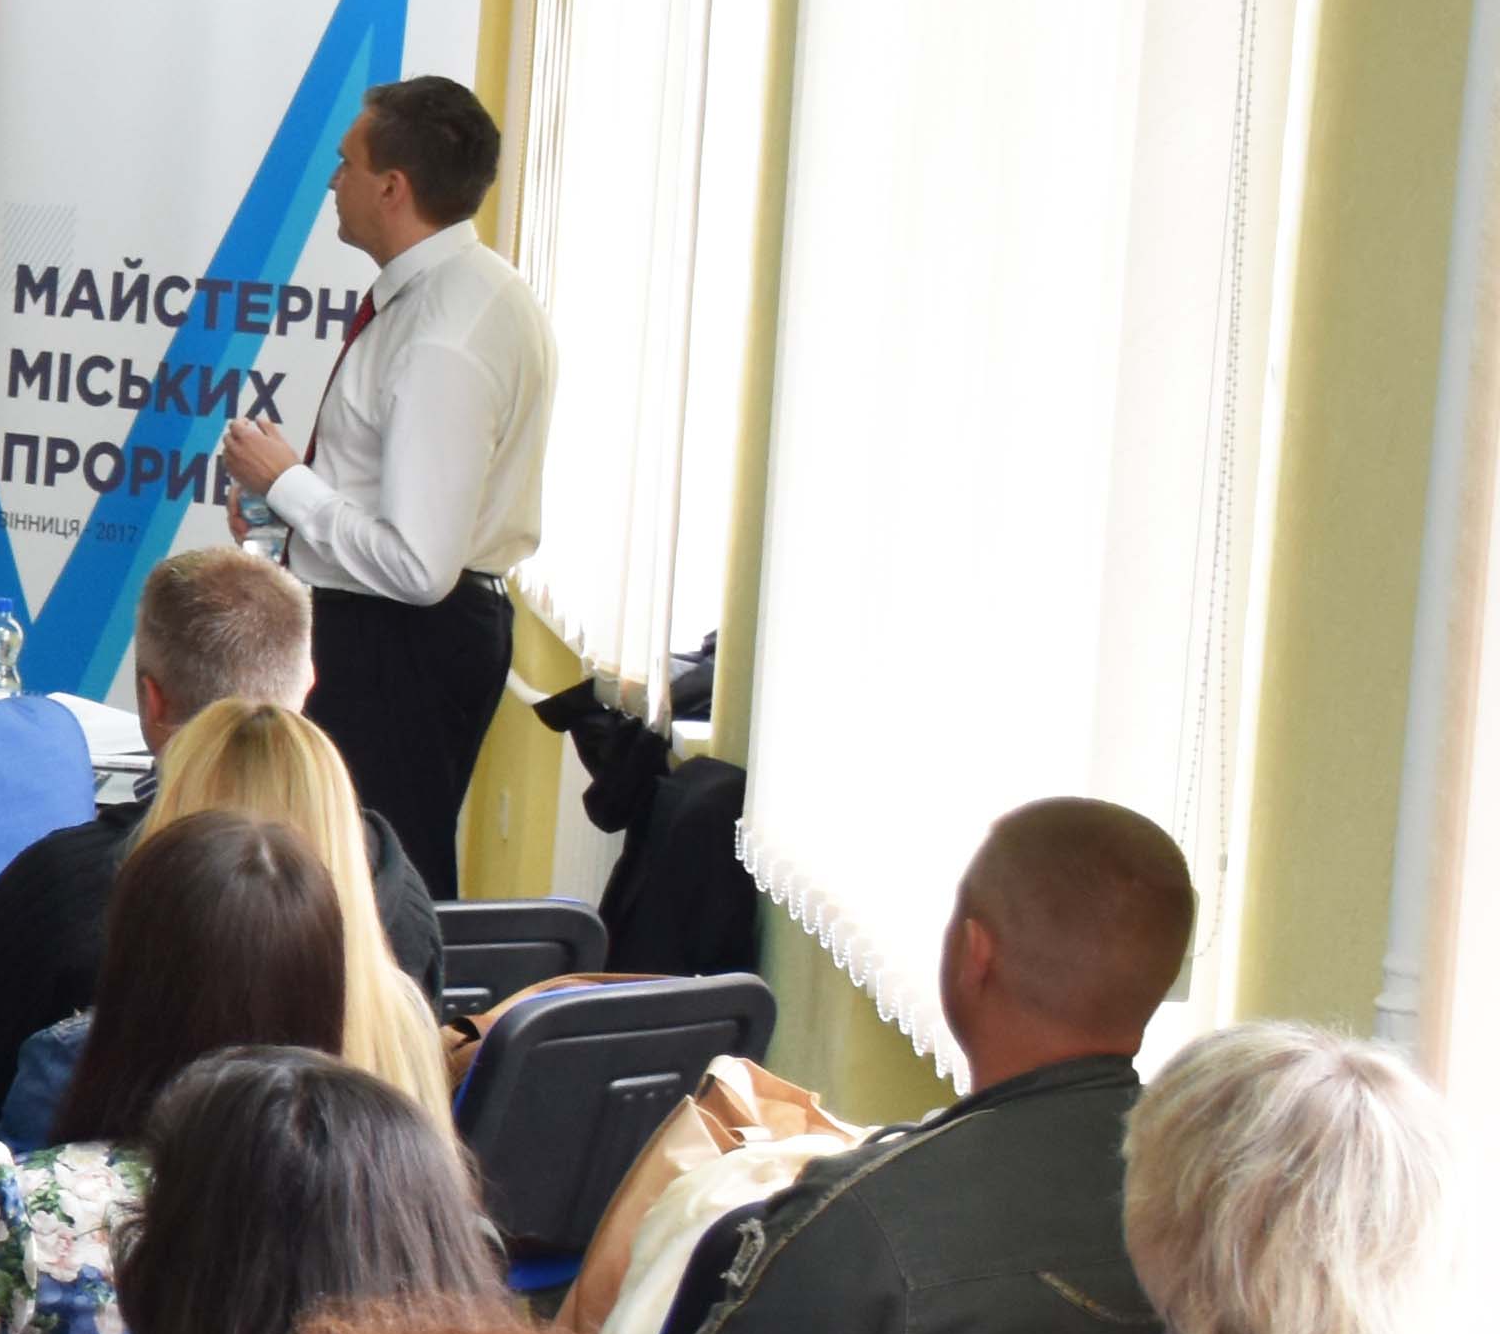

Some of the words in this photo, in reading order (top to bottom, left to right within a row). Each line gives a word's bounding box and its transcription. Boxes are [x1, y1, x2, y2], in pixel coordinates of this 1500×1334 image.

[14, 256, 358, 341] МАЙСТЕРН
[7, 348, 287, 424] МІСЬКИХ
[1, 431, 233, 506] ПРОРИ
[96, 521, 138, 543] 2017
